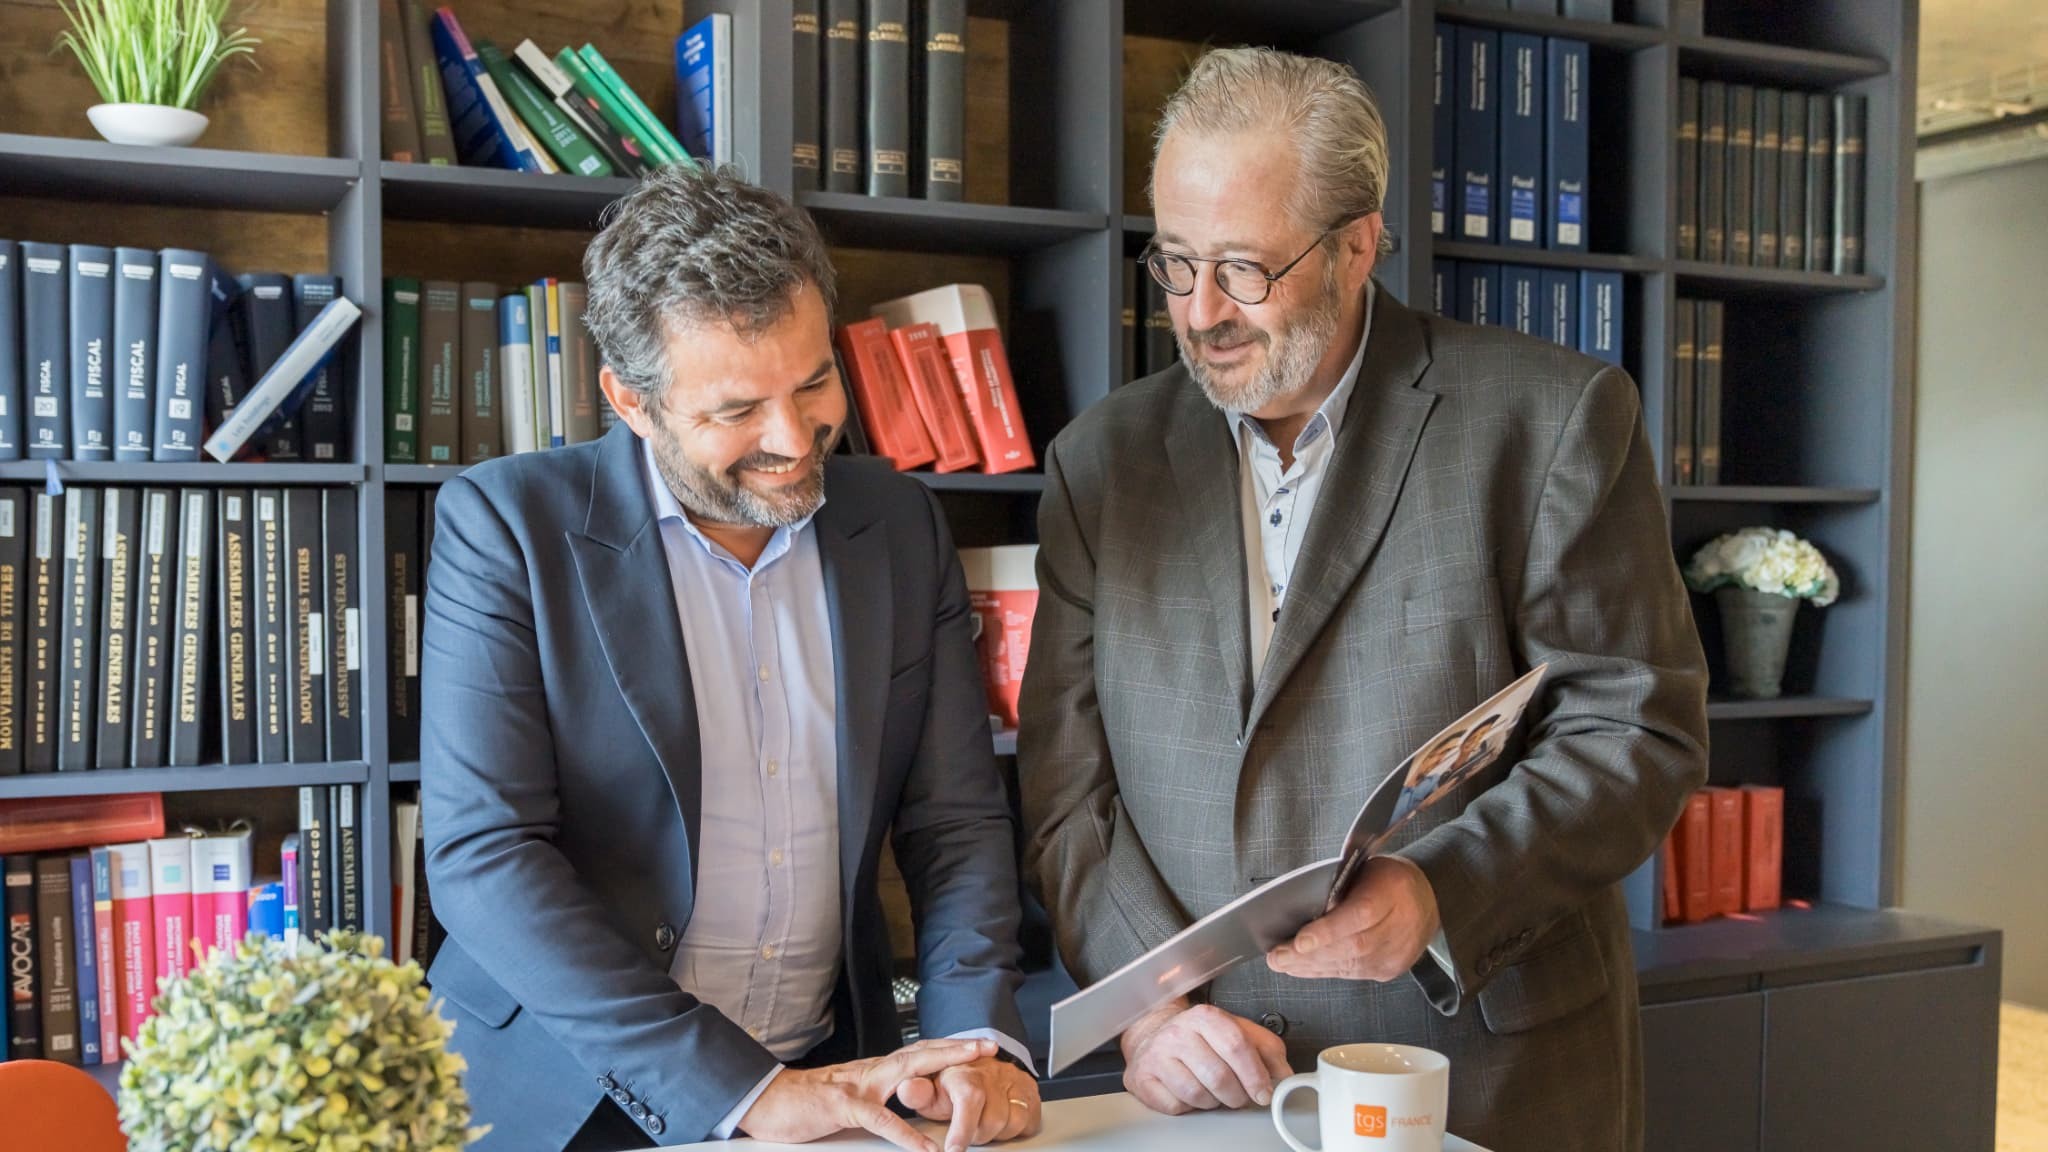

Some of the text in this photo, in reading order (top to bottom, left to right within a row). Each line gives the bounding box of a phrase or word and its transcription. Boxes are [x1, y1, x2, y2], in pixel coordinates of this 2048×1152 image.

[40, 360, 51, 393] FISCAL
[88, 338, 102, 385] FISCAL
[130, 340, 144, 386] FISCAL
[175, 362, 188, 396] FISCAL
[0, 565, 14, 750] MOUVEMENTS DE TITRES
[36, 556, 49, 744] VEMENTS DES TITRES
[74, 638, 82, 668] DES
[106, 532, 127, 724] ASSEMBLEES GENERALES
[145, 554, 160, 739] VEMENTS DES TITRES
[181, 556, 200, 722] EMBLEES GENERALES
[228, 532, 245, 720] ASSEMBLEES GENERALES
[265, 522, 278, 734] MOUVEMENTS DES TITRES
[298, 548, 313, 724] MOUVEMENTS DES TITRES
[72, 680, 81, 742] TITRES
[310, 819, 322, 918] MOUVEMENTS
[343, 828, 356, 920] ASSEMBLEES
[11, 921, 32, 996] AVOCAT
[1356, 1112, 1432, 1132] tgs FRANCE
